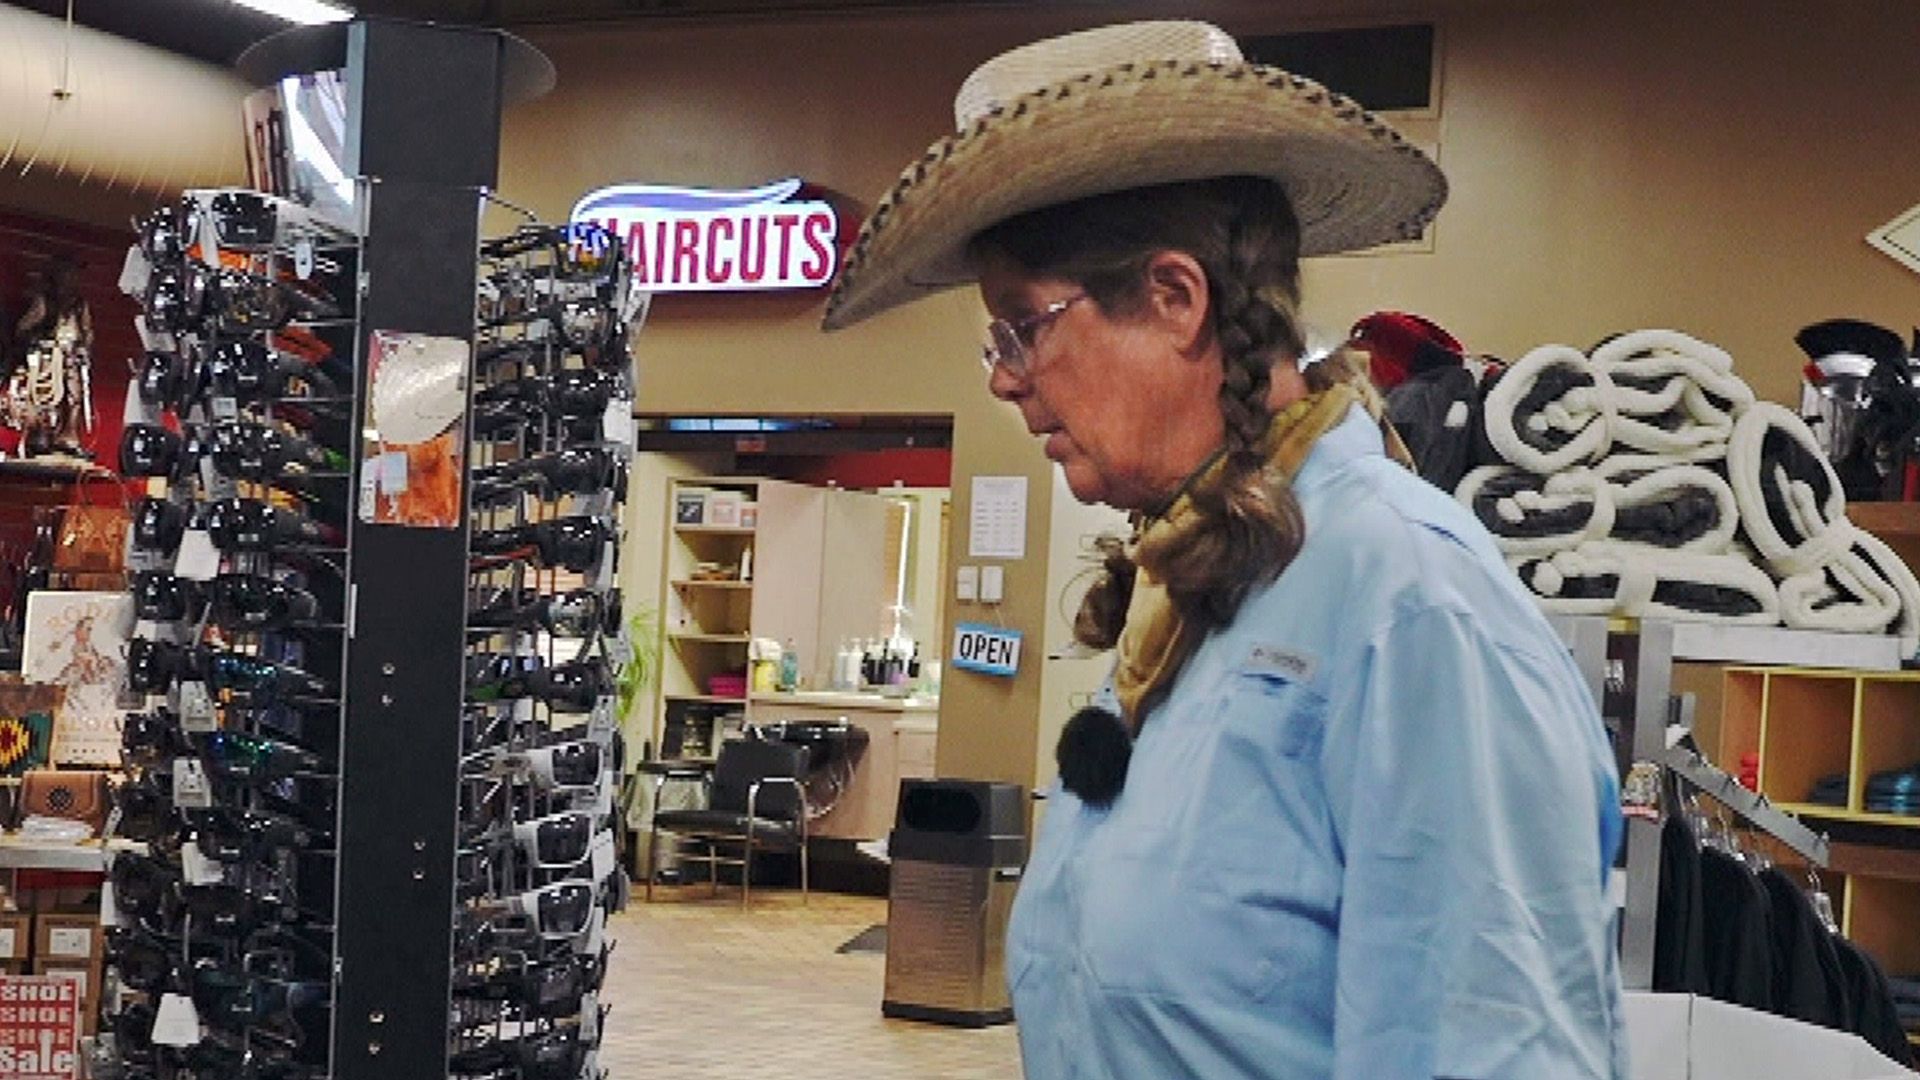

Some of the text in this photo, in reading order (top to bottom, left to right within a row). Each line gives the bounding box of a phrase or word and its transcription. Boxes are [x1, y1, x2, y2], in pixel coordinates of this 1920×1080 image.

[589, 212, 832, 284] AIRCUTS
[959, 633, 1014, 665] OPEN
[0, 985, 73, 1001] SHOE
[0, 1007, 72, 1022] SHOE
